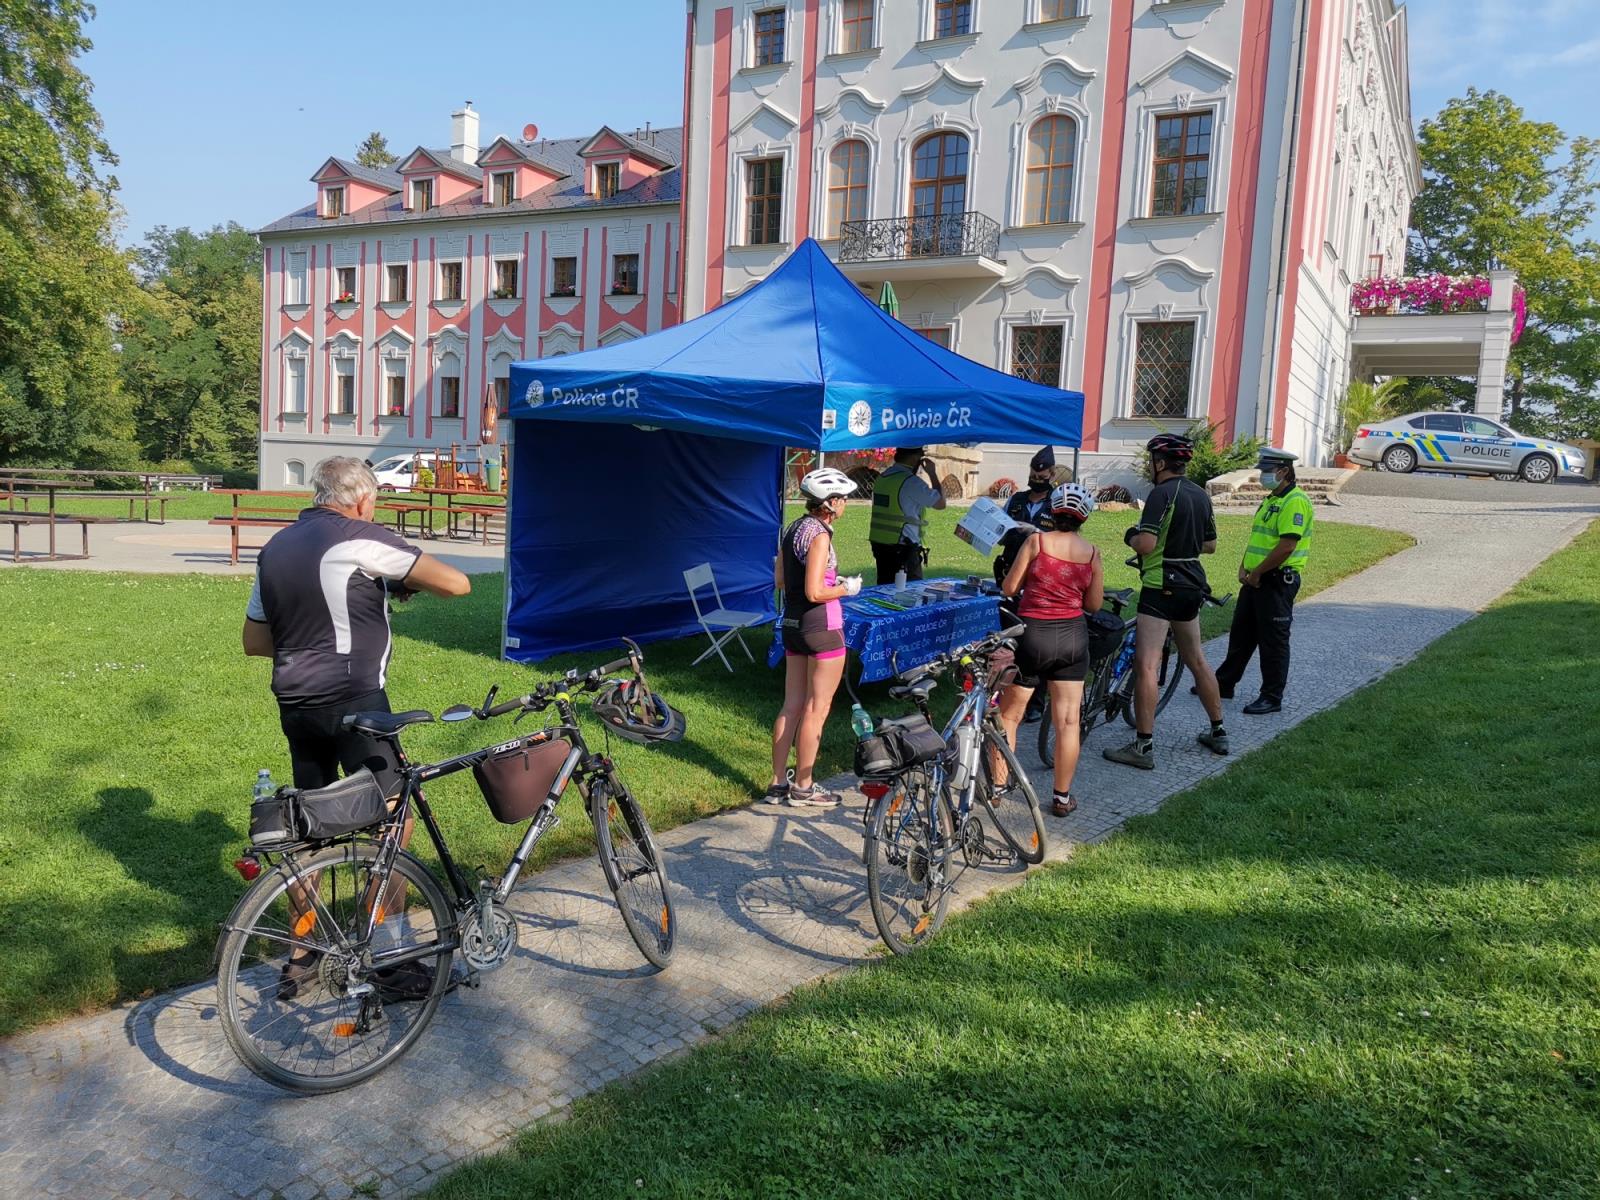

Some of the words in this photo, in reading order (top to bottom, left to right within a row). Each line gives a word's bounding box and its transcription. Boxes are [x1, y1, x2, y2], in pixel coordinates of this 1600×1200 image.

[551, 387, 606, 407] Policie
[612, 383, 640, 409] ČR
[881, 408, 942, 431] Policie
[946, 401, 971, 427] ČR
[1463, 445, 1511, 458] POLICIE
[914, 621, 938, 633] POLICIE
[936, 631, 957, 643] POLICIE
